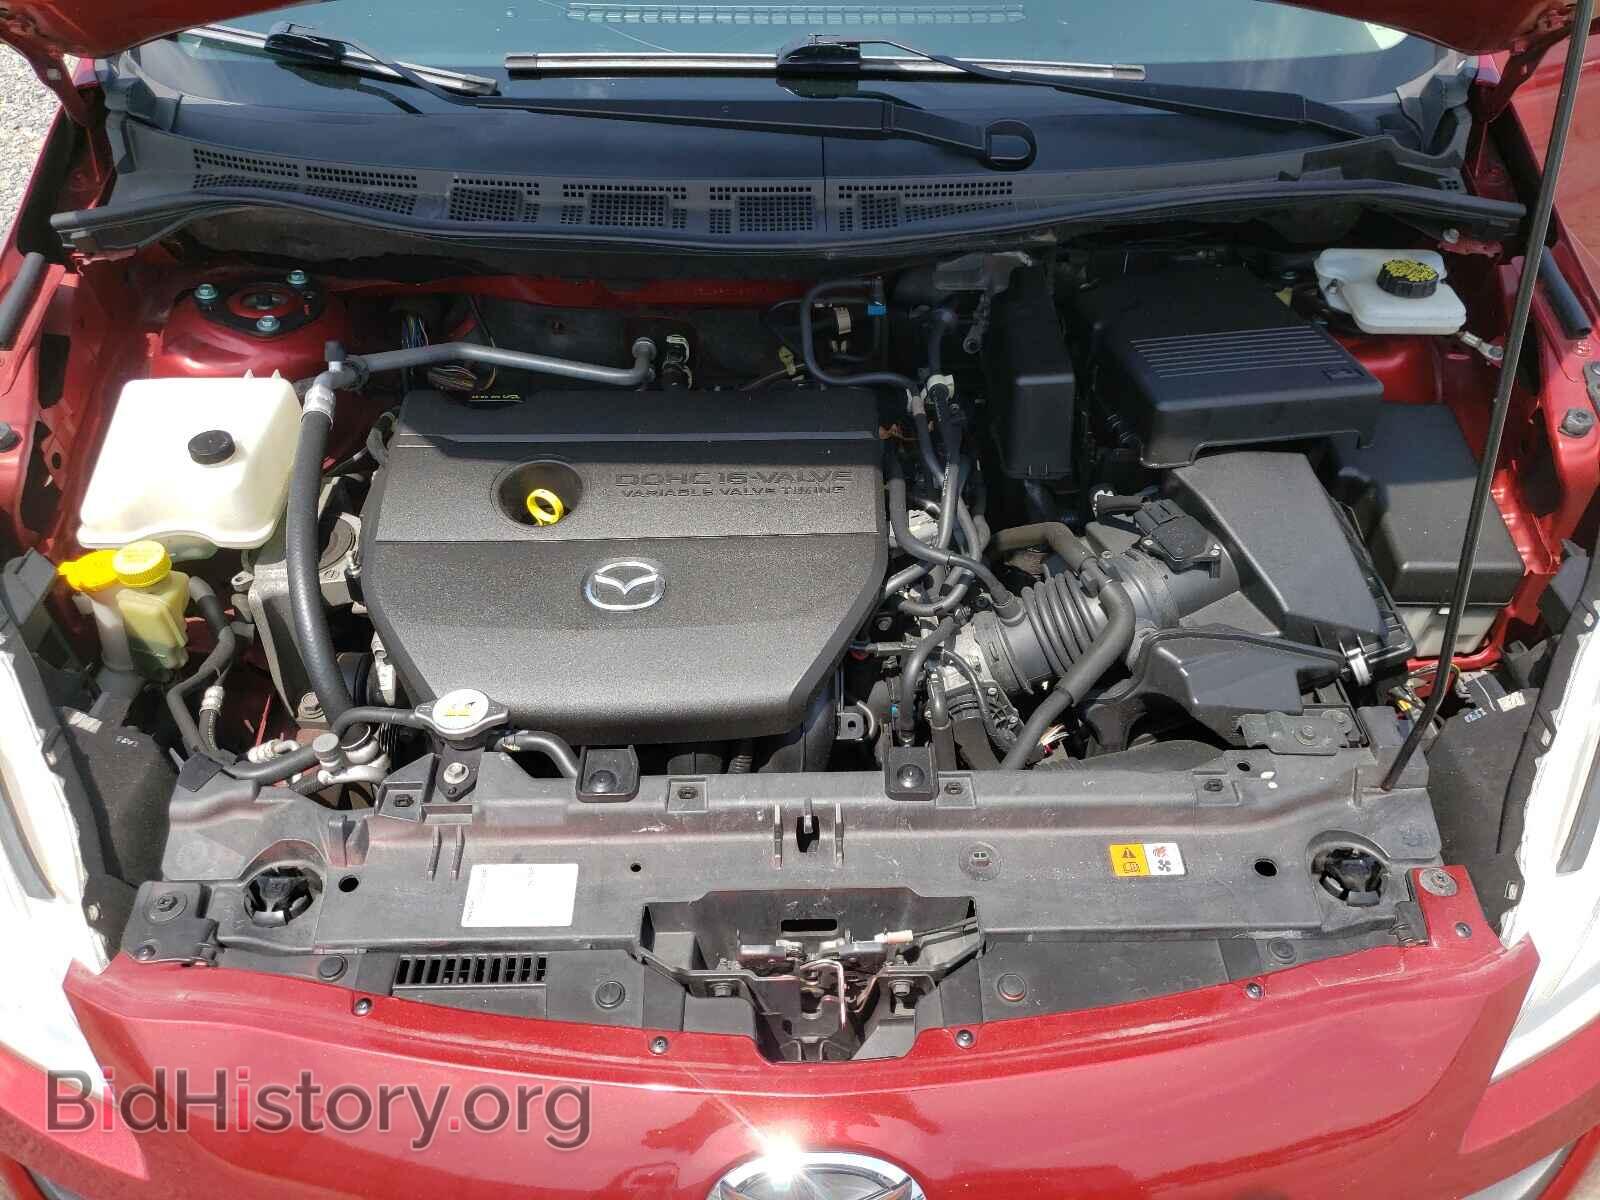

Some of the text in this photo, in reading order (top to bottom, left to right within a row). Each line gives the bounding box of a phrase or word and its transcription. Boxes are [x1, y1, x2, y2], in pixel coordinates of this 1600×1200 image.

[615, 470, 853, 487] DOHC 16-VALVE
[621, 485, 846, 498] VARIABLE VALVE TIMING
